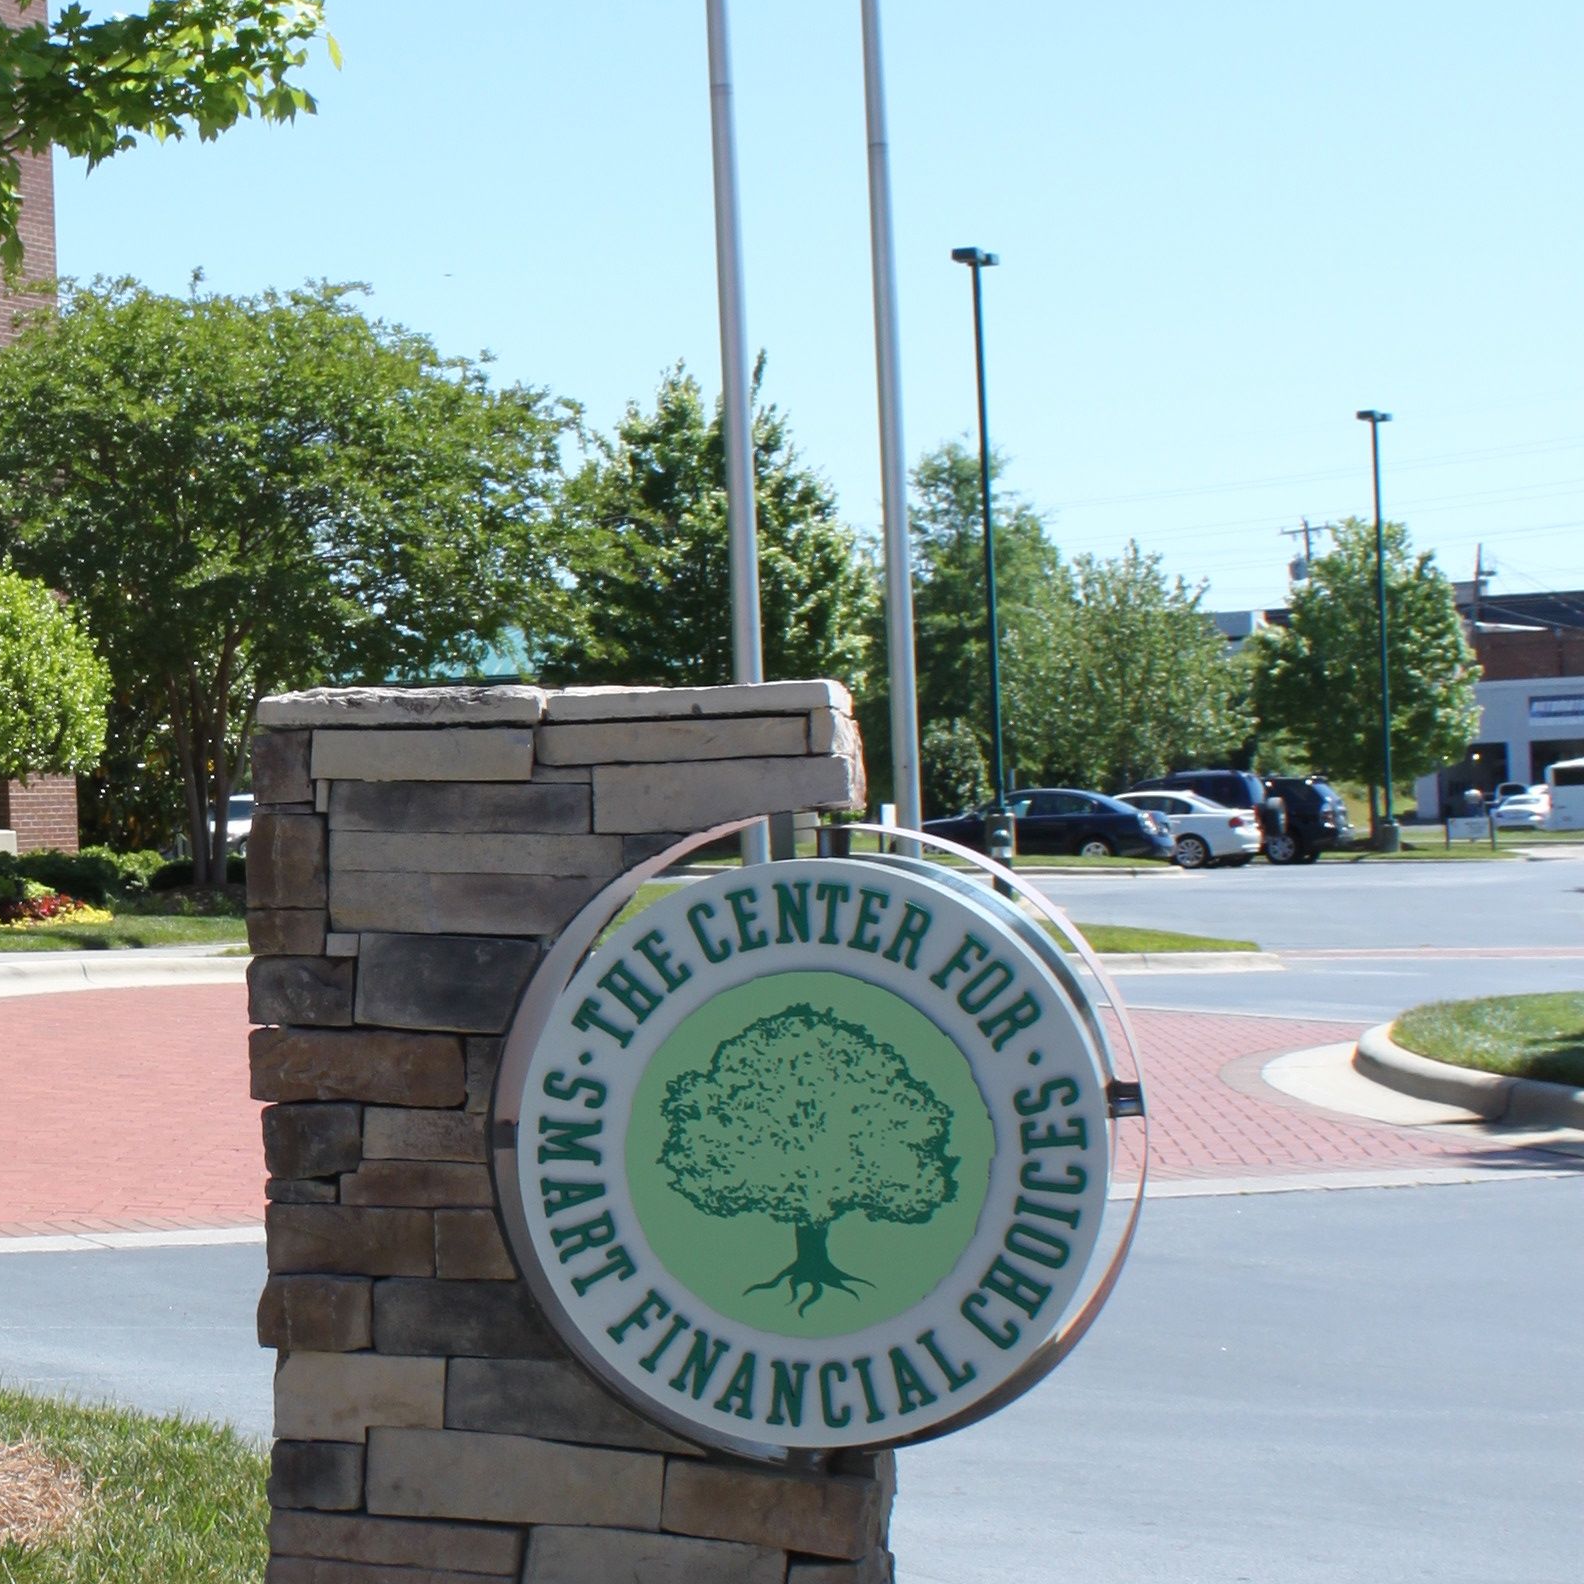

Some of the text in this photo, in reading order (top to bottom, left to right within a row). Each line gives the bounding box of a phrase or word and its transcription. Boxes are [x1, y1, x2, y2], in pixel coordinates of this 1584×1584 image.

[574, 877, 1045, 1053] THE CENTER FOR
[539, 1069, 1092, 1430] SMART FINANCIAL CHOICES
